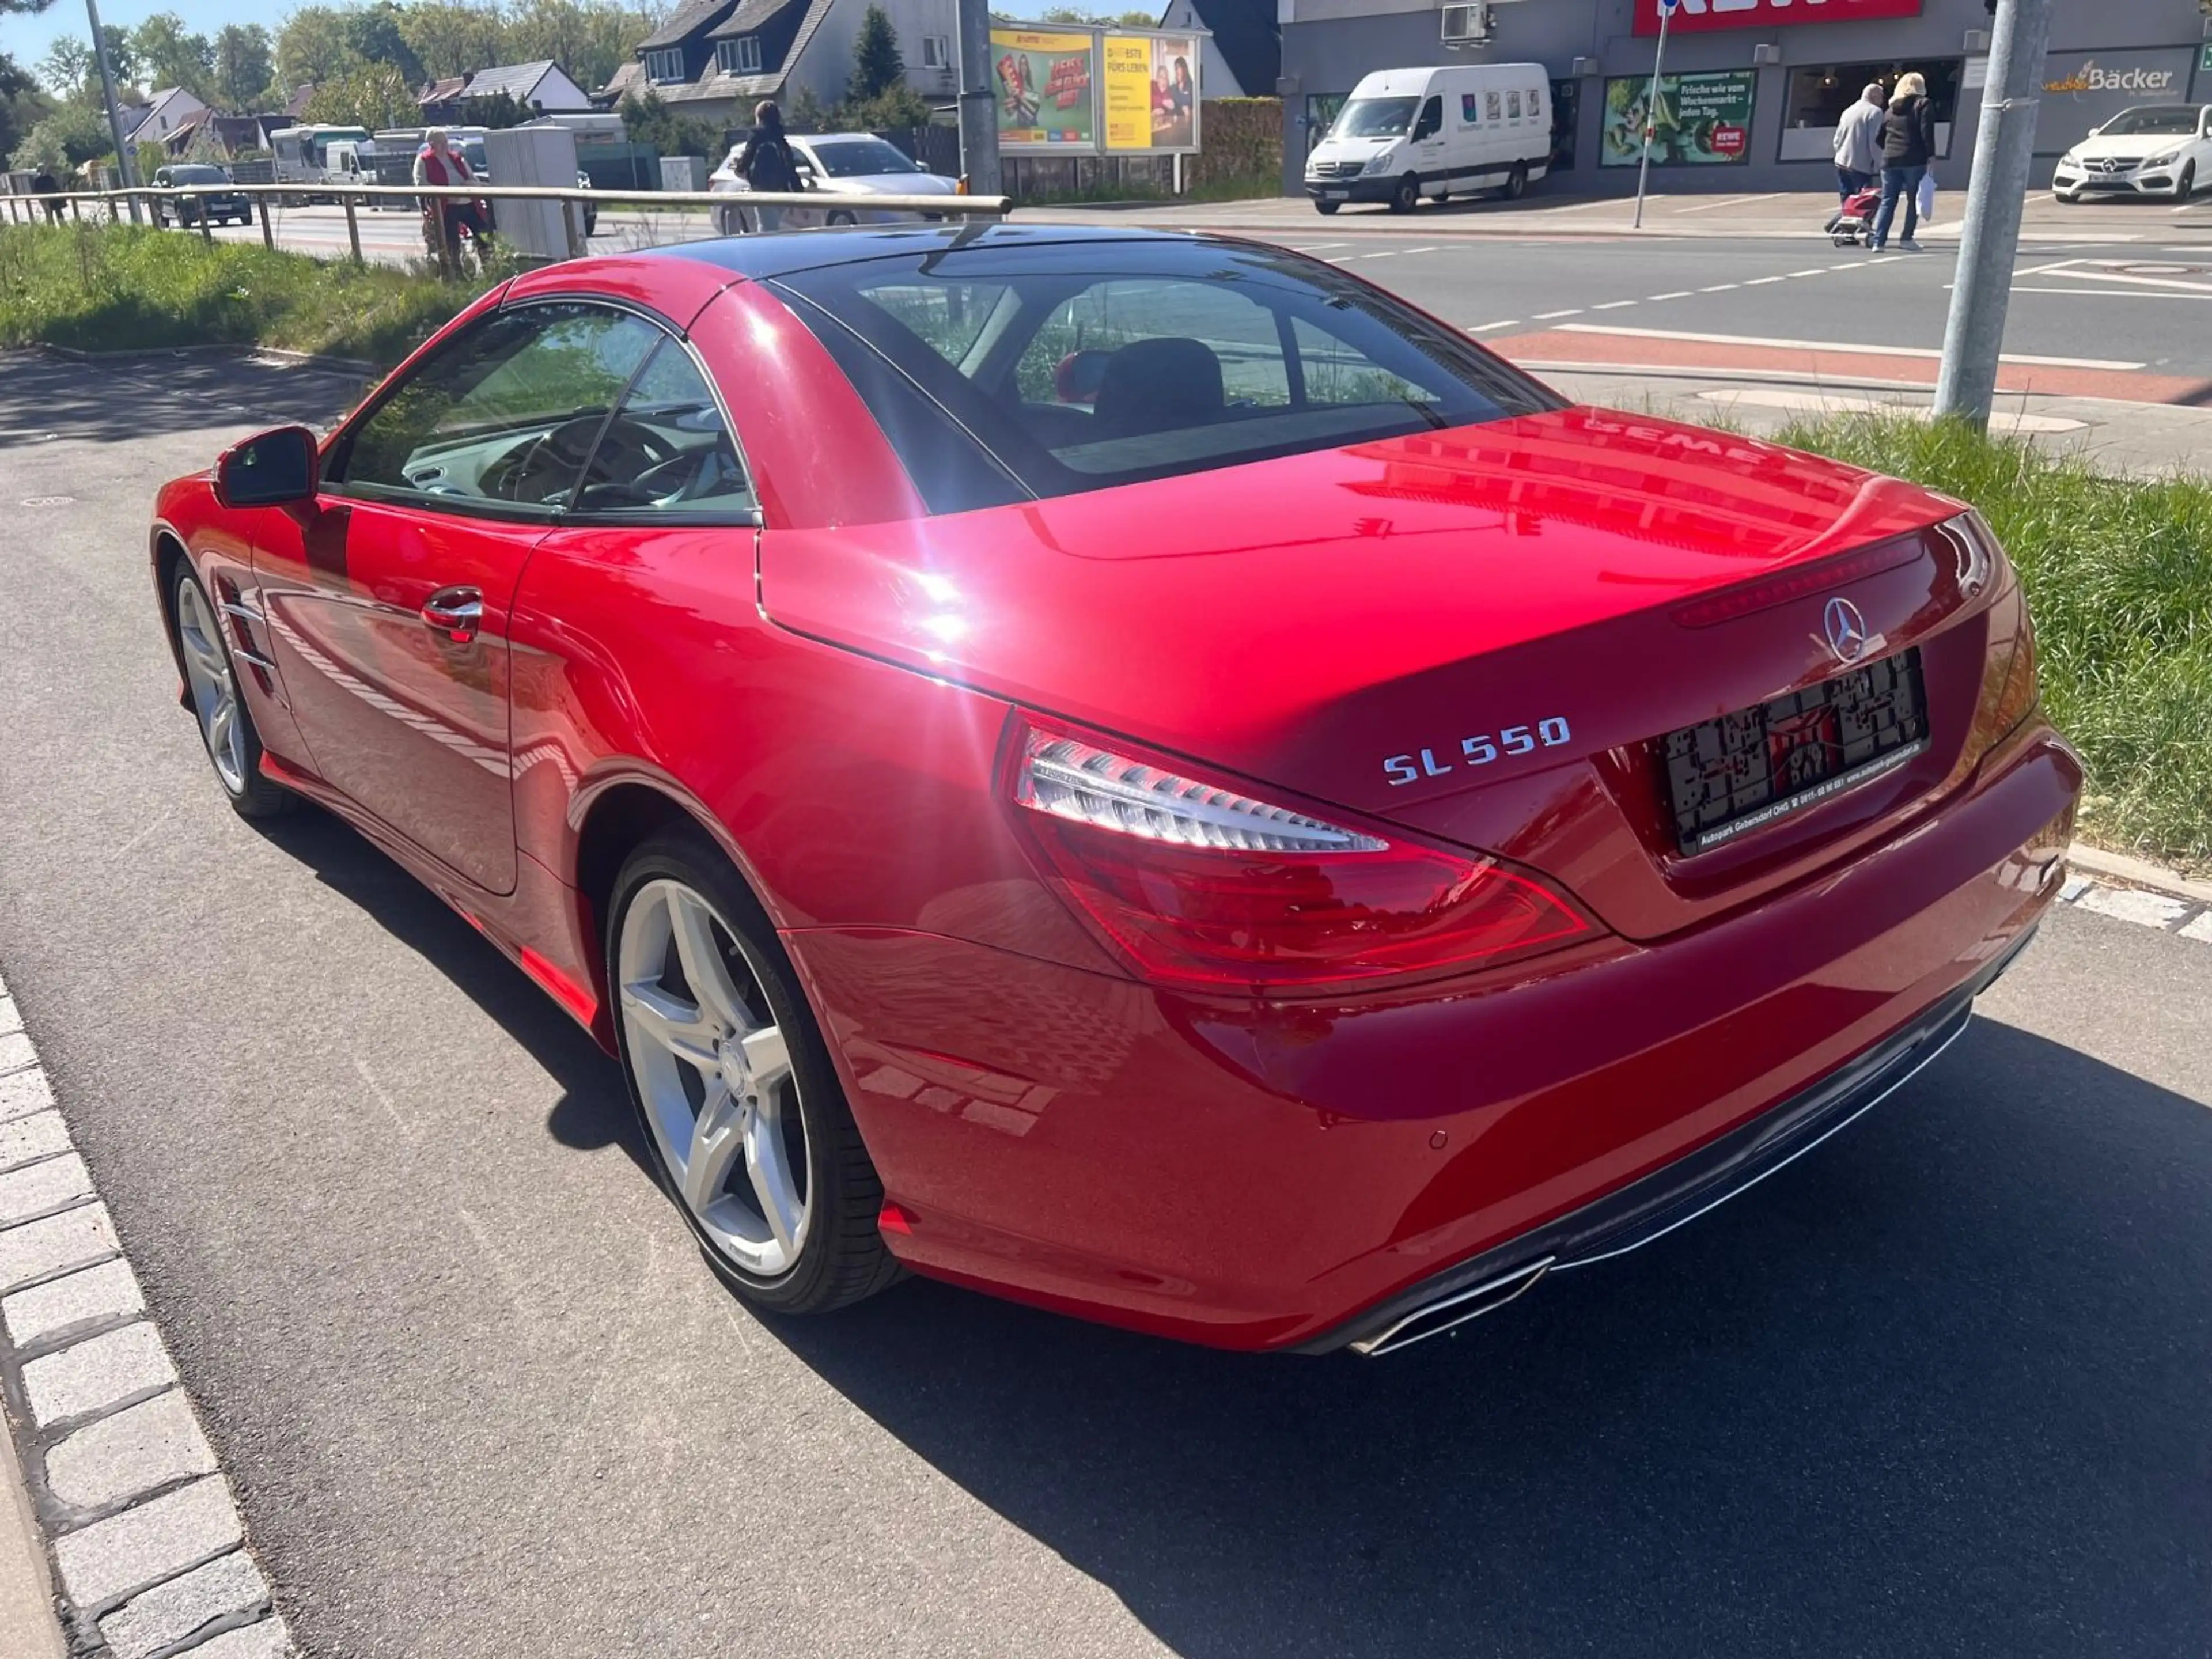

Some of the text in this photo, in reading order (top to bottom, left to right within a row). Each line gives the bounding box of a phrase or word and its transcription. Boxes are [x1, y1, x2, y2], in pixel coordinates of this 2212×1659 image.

[1681, 84, 1710, 94] Frische
[1711, 83, 1726, 93] wie
[1680, 94, 1736, 105] Wochenmarkt
[1678, 107, 1719, 119] jeden Tag.
[1384, 717, 1571, 786] SL 550
[1701, 825, 1734, 846] Autopark
[1735, 808, 1772, 831] Gebersdorf
[1774, 802, 1789, 815] OHG
